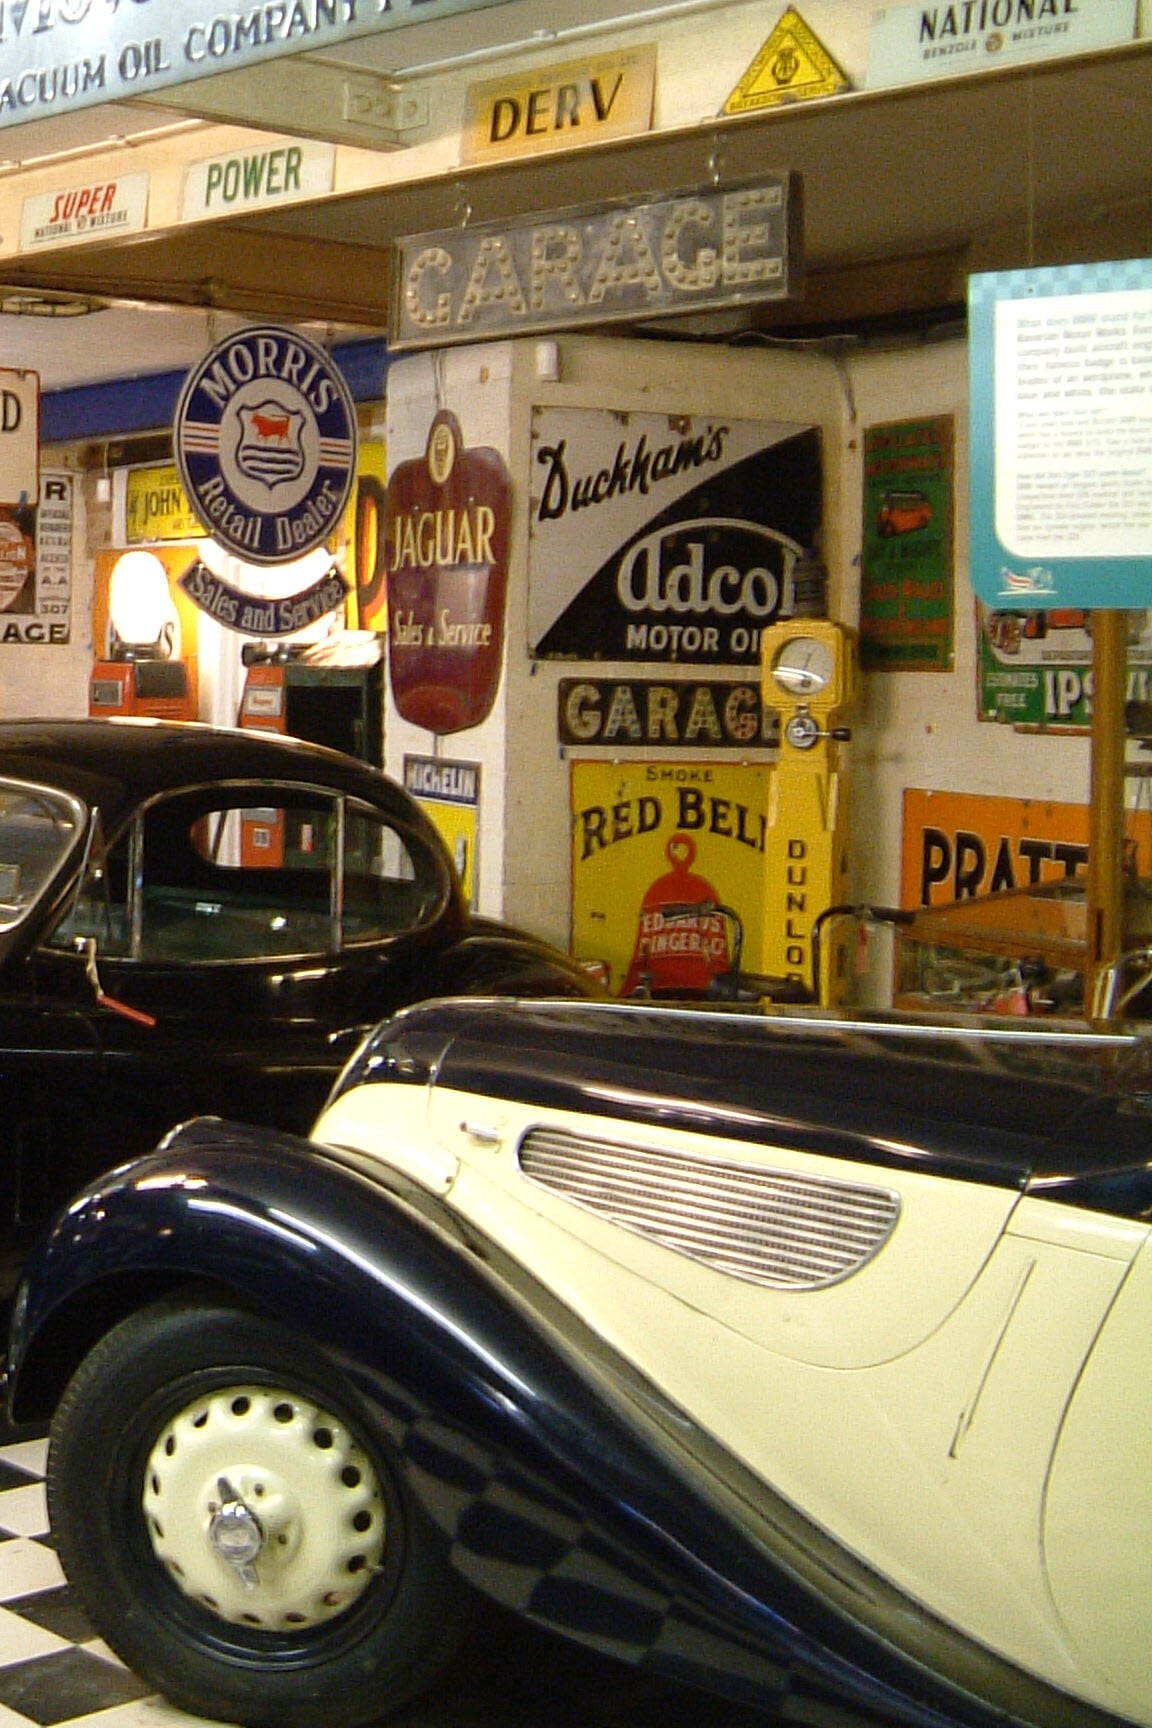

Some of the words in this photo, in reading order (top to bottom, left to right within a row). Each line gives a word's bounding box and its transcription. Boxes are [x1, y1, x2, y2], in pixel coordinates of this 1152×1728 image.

[118, 40, 171, 82] OIL
[1012, 22, 1071, 42] MIXTURE
[489, 73, 624, 143] DERV
[50, 183, 117, 223] SUPER
[205, 146, 303, 206] POWER
[87, 210, 128, 227] MIXTURE
[404, 186, 784, 328] GARAGE
[198, 337, 339, 414] MORRIS
[538, 425, 730, 522] Duckham's
[143, 488, 182, 525] JOHN
[198, 476, 262, 549] Retail
[274, 480, 342, 548] Dealer
[391, 506, 496, 571] JAGUAR
[190, 570, 237, 623] Sales
[241, 609, 276, 632] and
[278, 579, 345, 631] Service
[394, 609, 423, 646] Sales
[439, 608, 491, 646] Service
[627, 624, 719, 651] MOTOR
[730, 631, 762, 653] OI
[580, 796, 663, 861] RED
